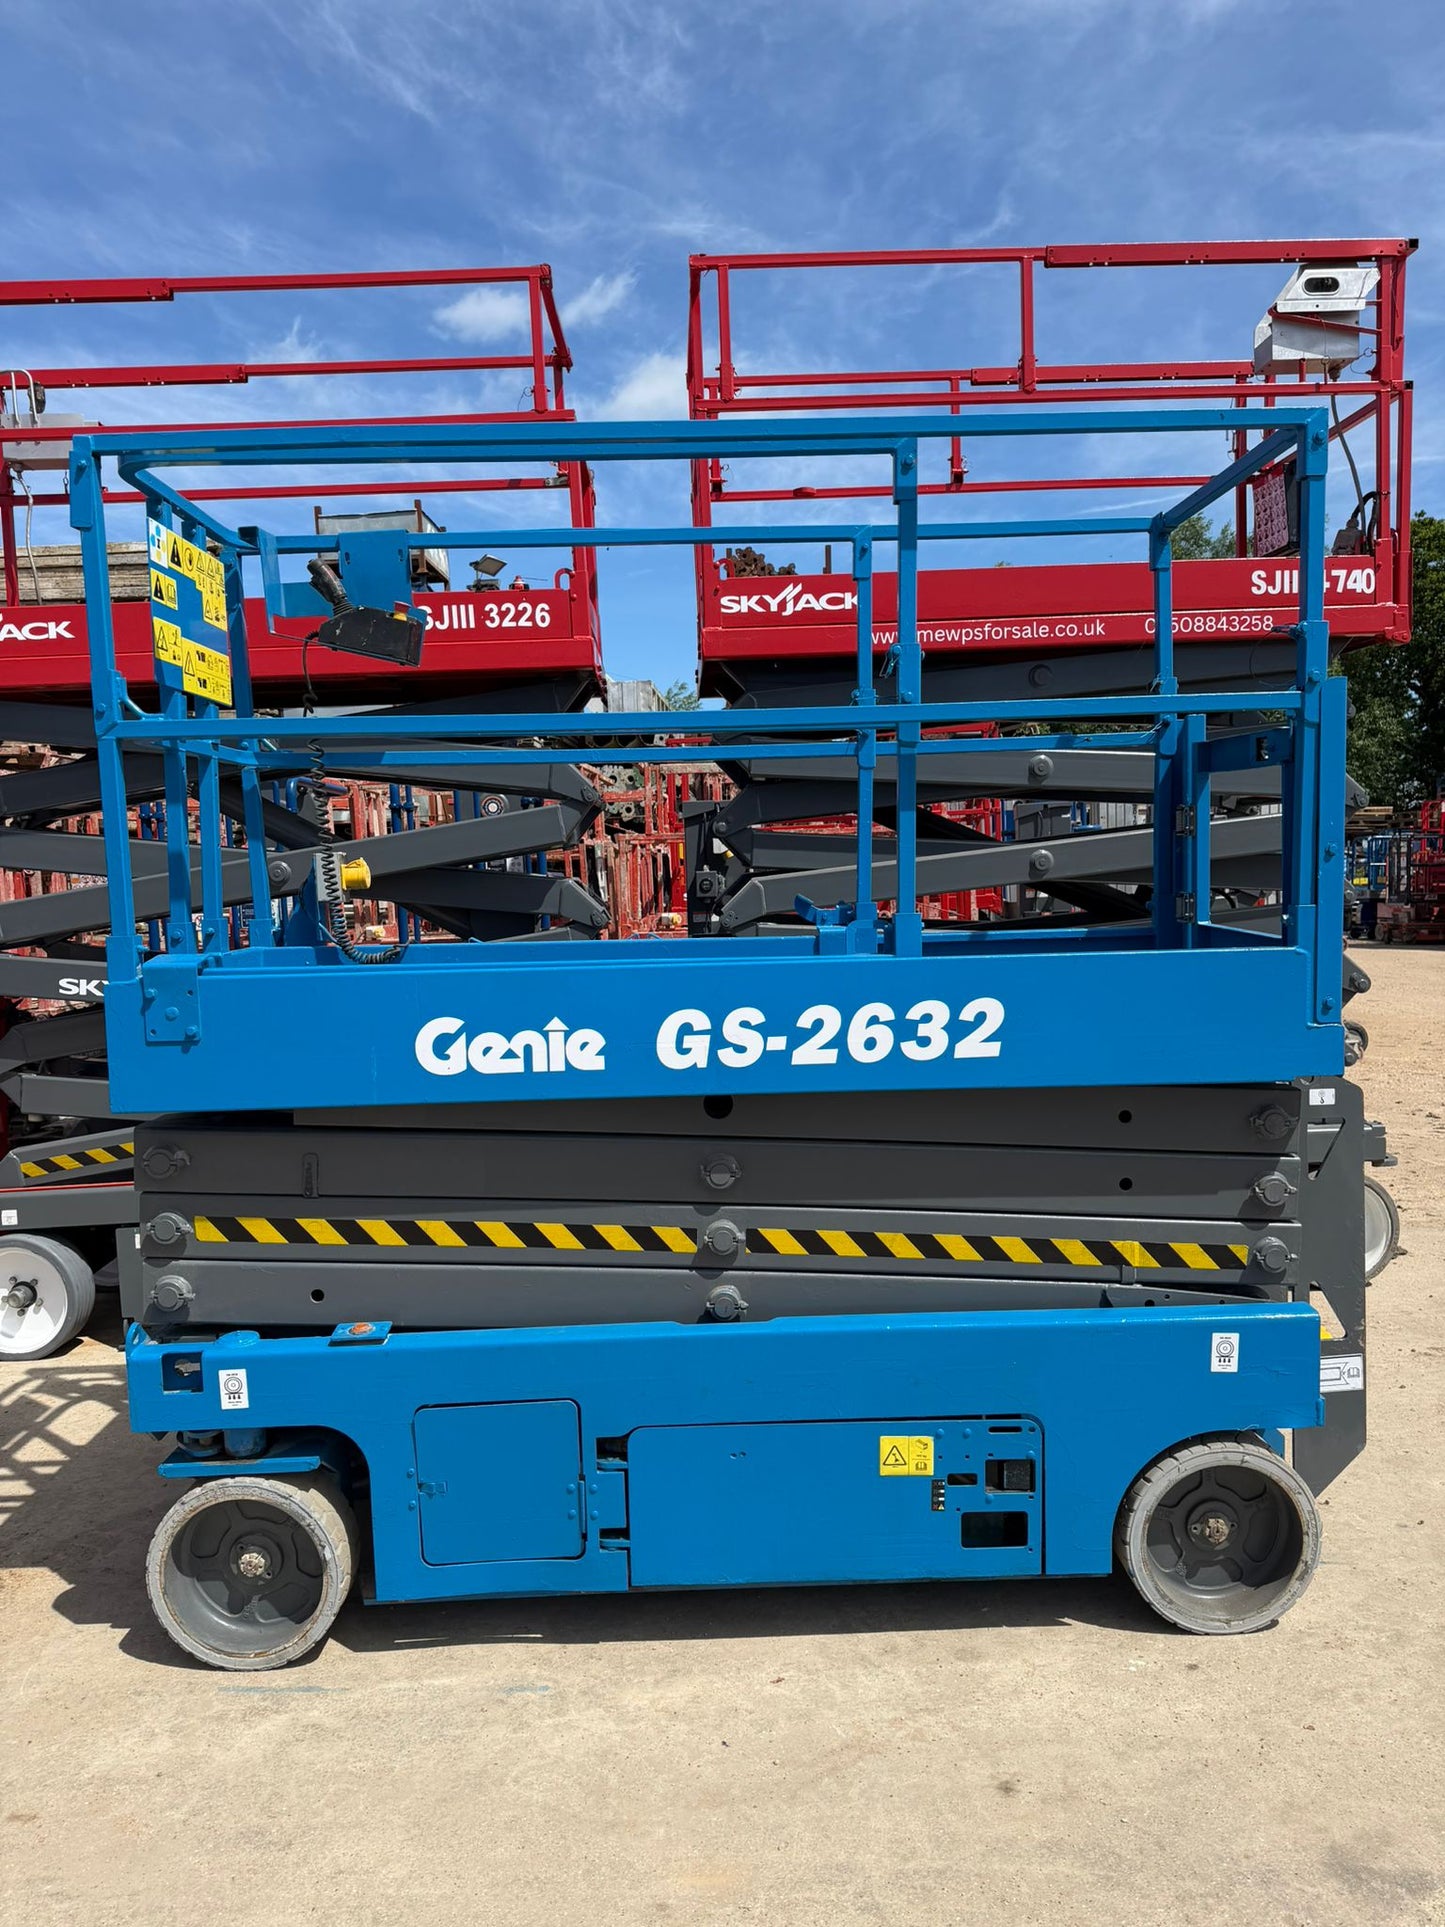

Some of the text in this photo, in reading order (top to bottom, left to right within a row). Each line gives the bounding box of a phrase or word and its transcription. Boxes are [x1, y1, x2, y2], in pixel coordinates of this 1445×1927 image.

[1251, 569, 1299, 595] SJII
[720, 582, 858, 616] SKYJACK
[0, 613, 76, 641] ACK
[417, 602, 551, 630] SJIII 3226
[1144, 614, 1274, 634] 0508843258
[58, 977, 110, 997] SK
[414, 1015, 607, 1076] Genie
[655, 996, 1006, 1071] GS-2632
